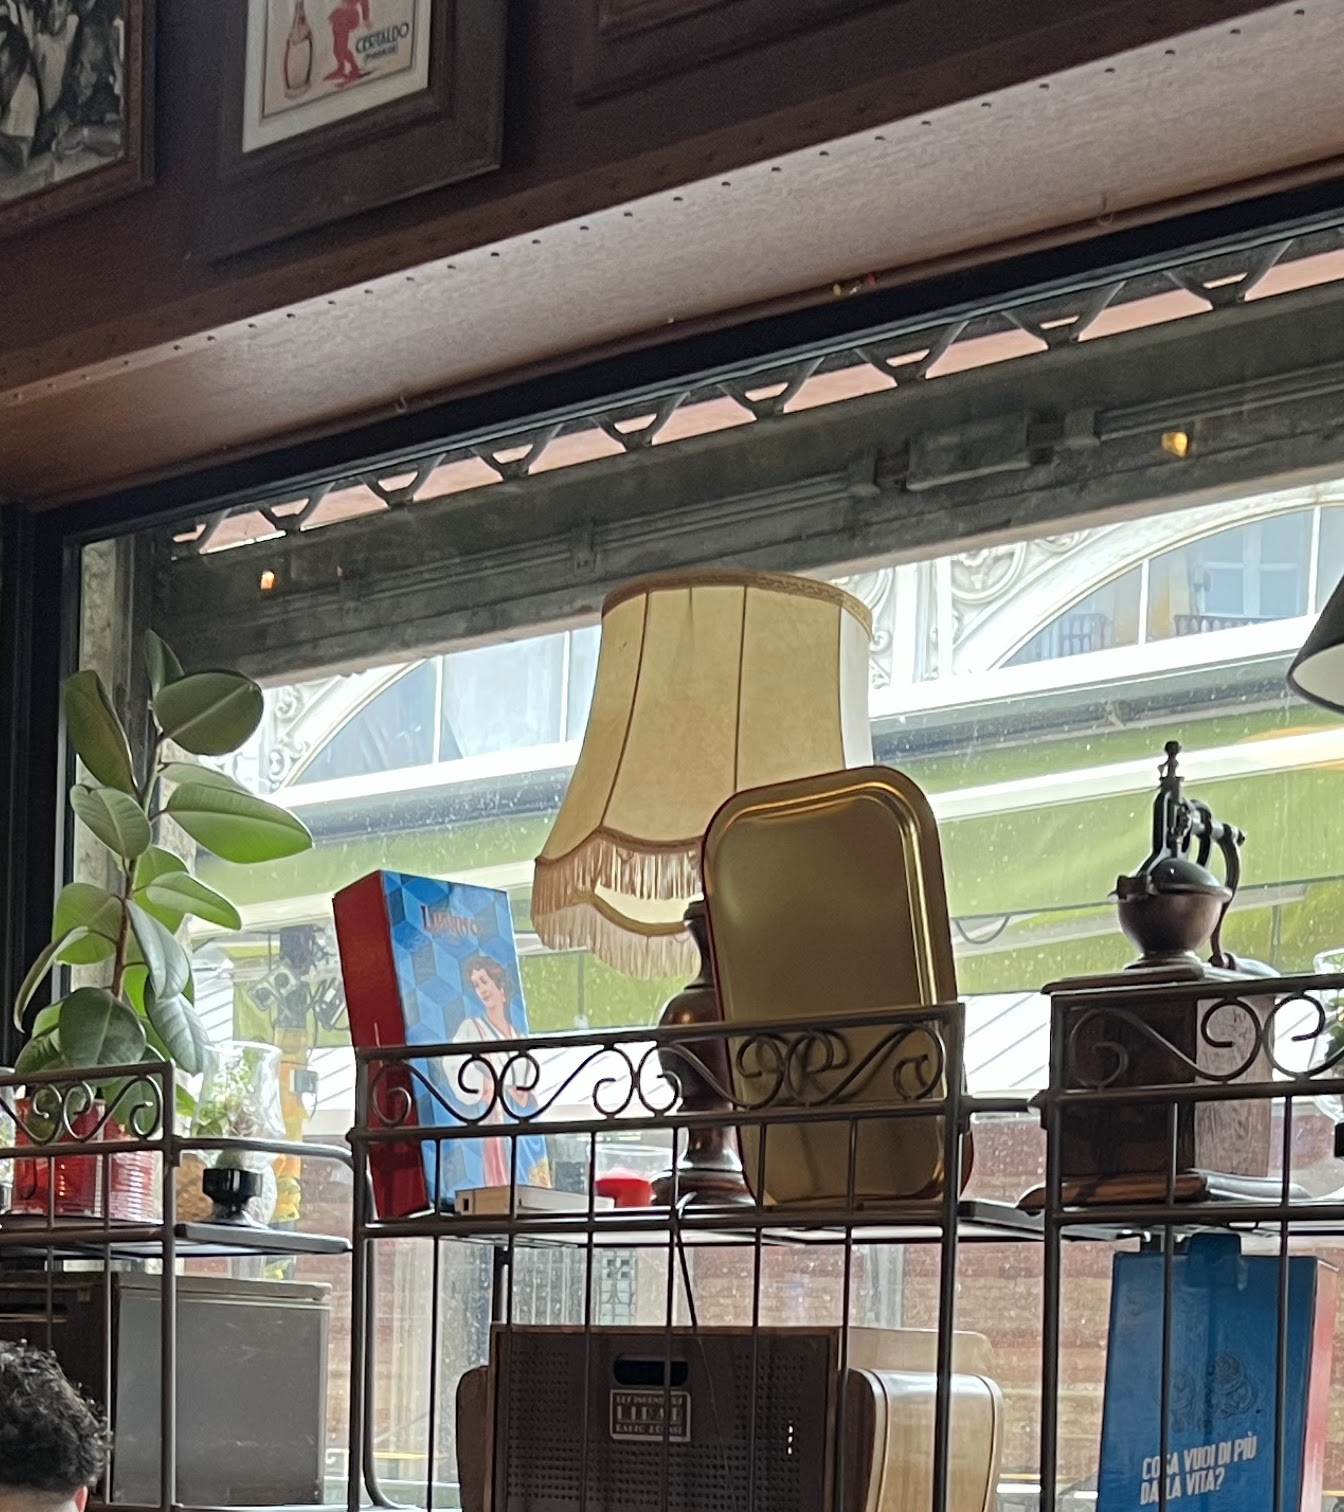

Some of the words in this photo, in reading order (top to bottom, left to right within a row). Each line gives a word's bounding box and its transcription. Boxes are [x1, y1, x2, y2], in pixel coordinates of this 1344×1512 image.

[1184, 1444, 1216, 1472] VUOI
[1218, 1441, 1232, 1466] DI
[1233, 1431, 1257, 1462] PIÙ
[1140, 1475, 1181, 1505] DALA
[1186, 1467, 1225, 1496] VITA?
